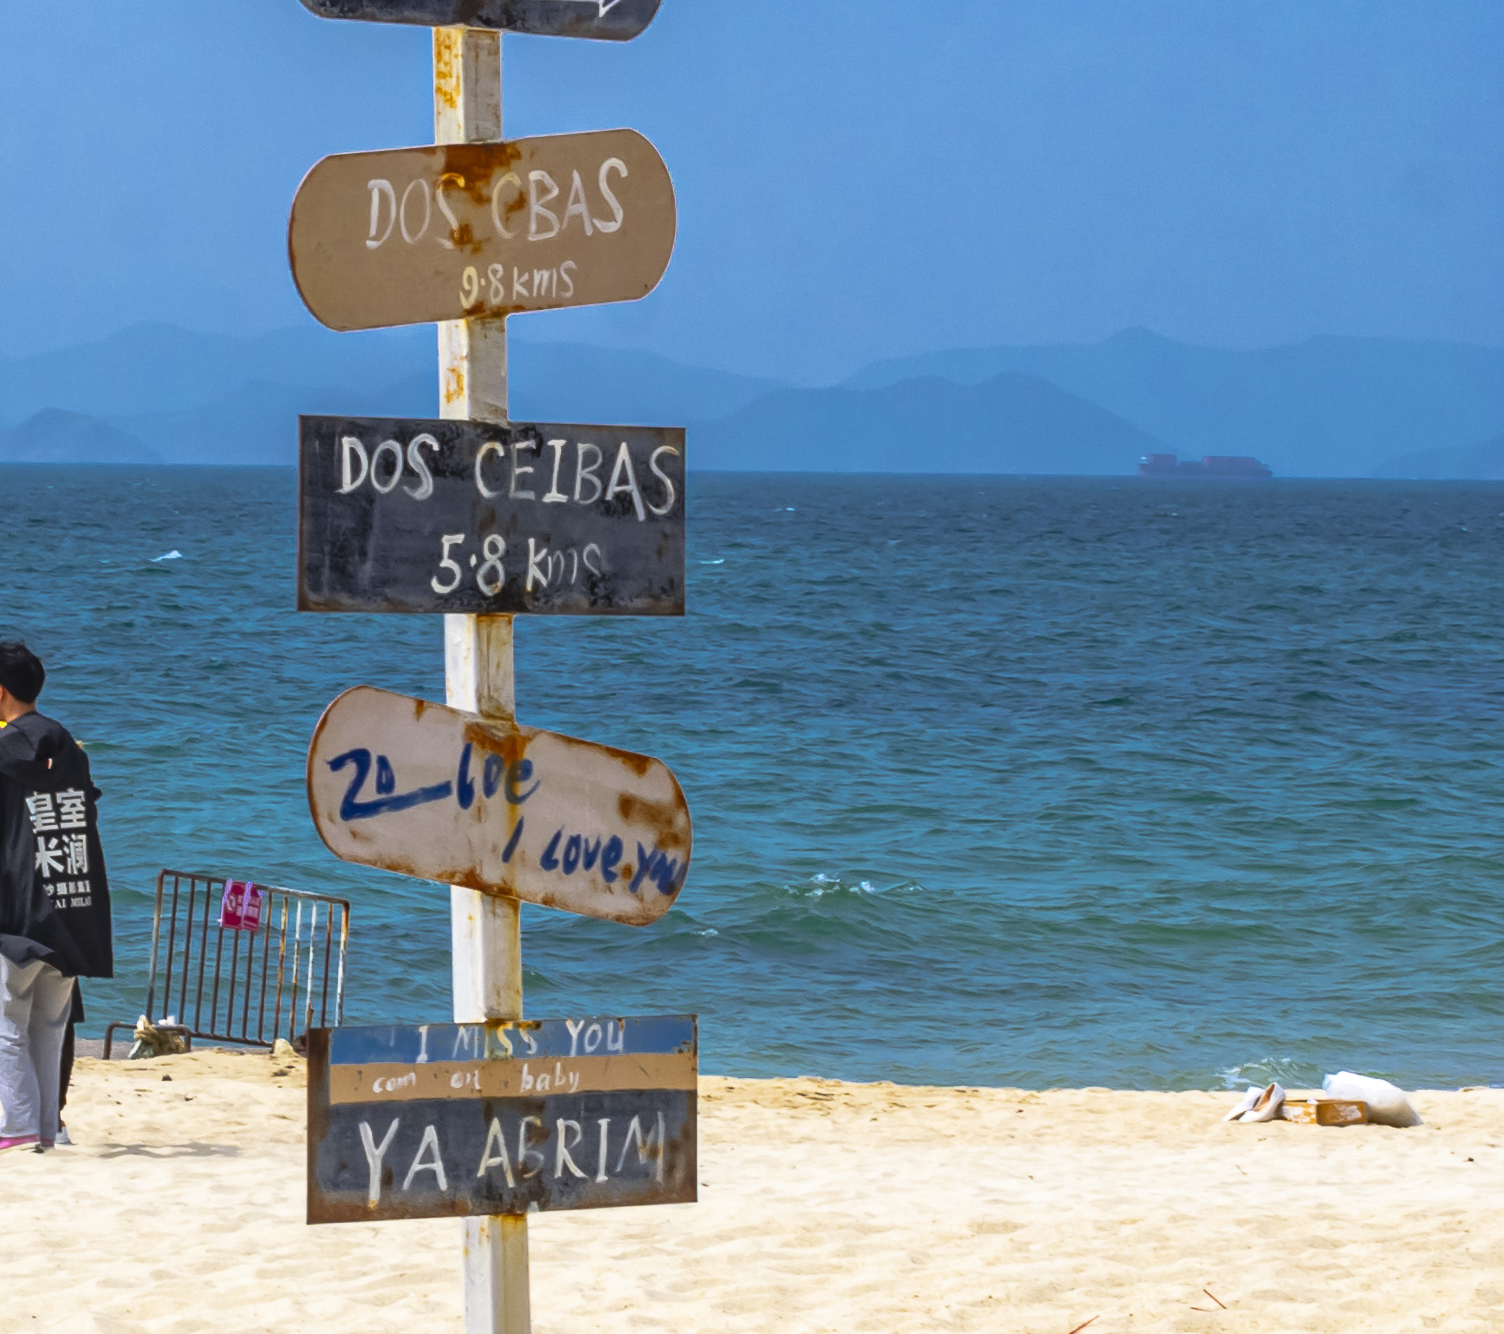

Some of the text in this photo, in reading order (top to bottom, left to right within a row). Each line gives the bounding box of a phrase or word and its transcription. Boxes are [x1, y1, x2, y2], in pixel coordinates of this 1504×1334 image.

[364, 157, 628, 250] DOS CBAS
[335, 432, 681, 522] DOS CEIBAS
[25, 787, 88, 834] 皇室
[416, 1018, 626, 1064] I MISS YOU
[519, 1062, 580, 1094] baby
[358, 1117, 449, 1211] YA
